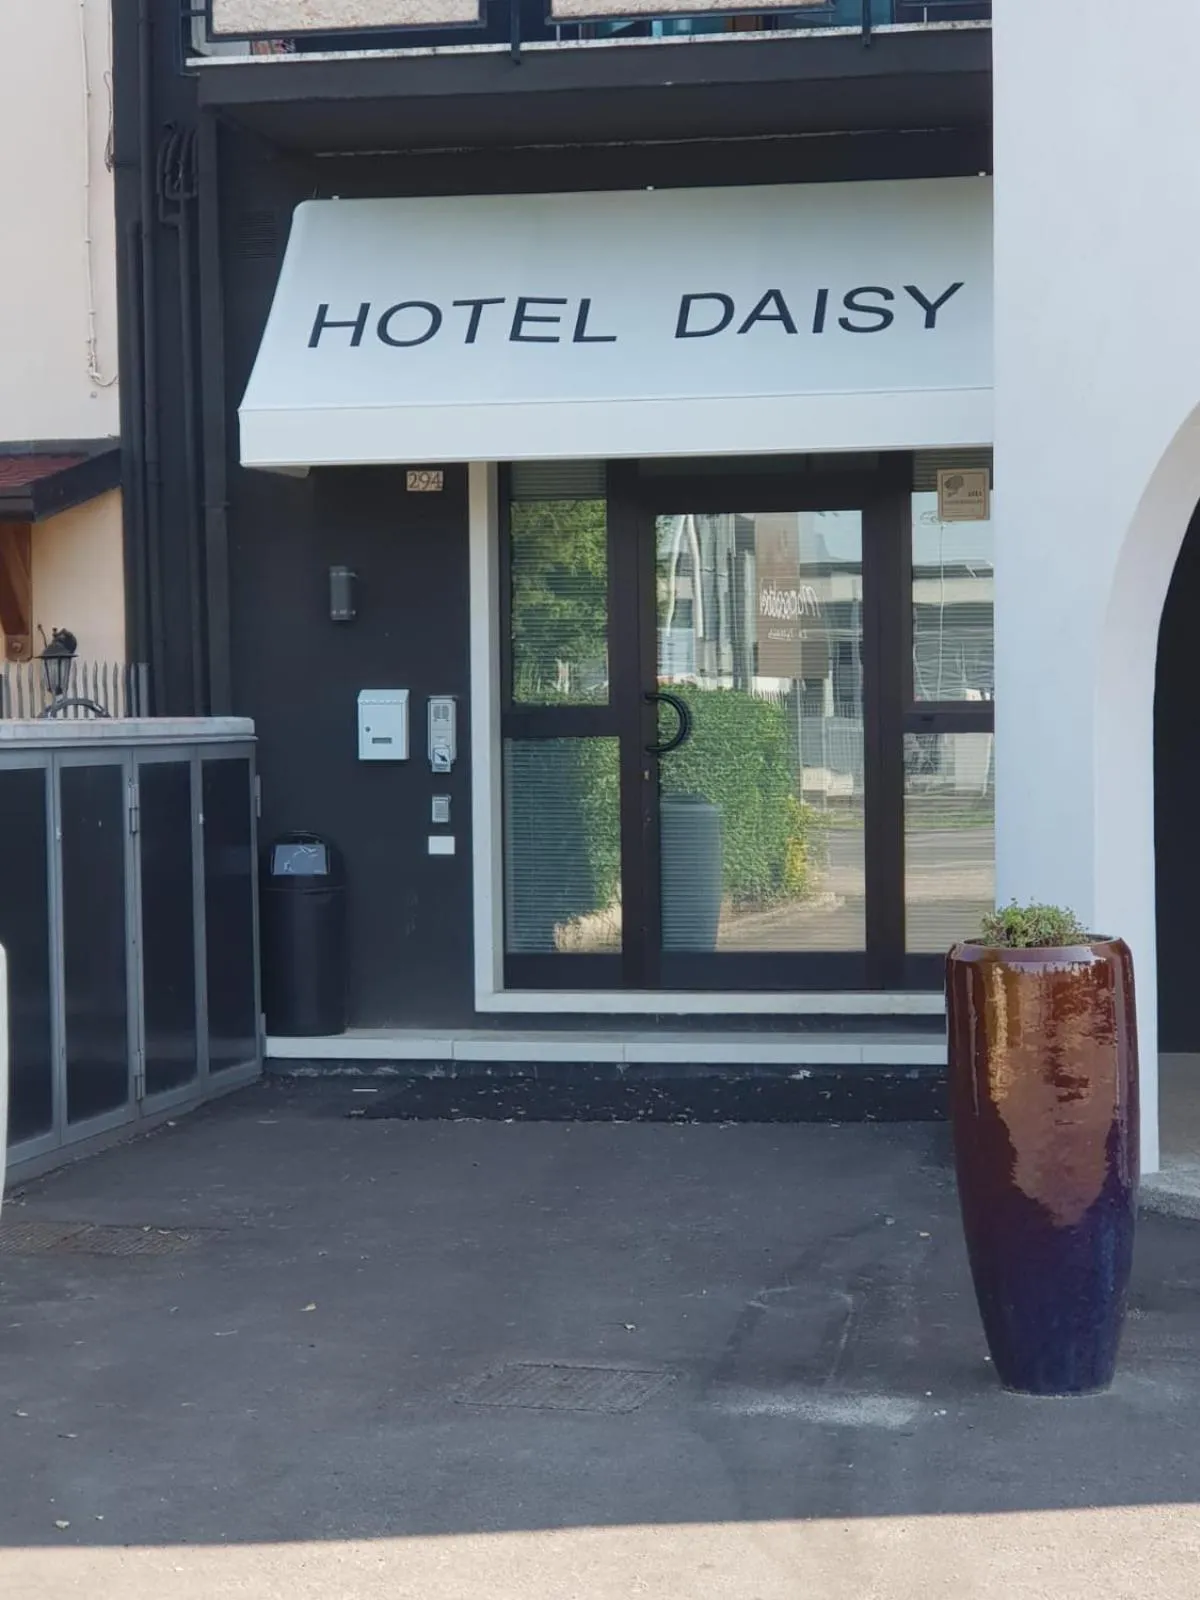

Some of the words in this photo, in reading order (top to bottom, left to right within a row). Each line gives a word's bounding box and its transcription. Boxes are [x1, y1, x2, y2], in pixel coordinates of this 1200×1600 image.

[308, 297, 617, 348] HOTEL
[675, 282, 965, 339] DAISY
[407, 471, 443, 491] 294
